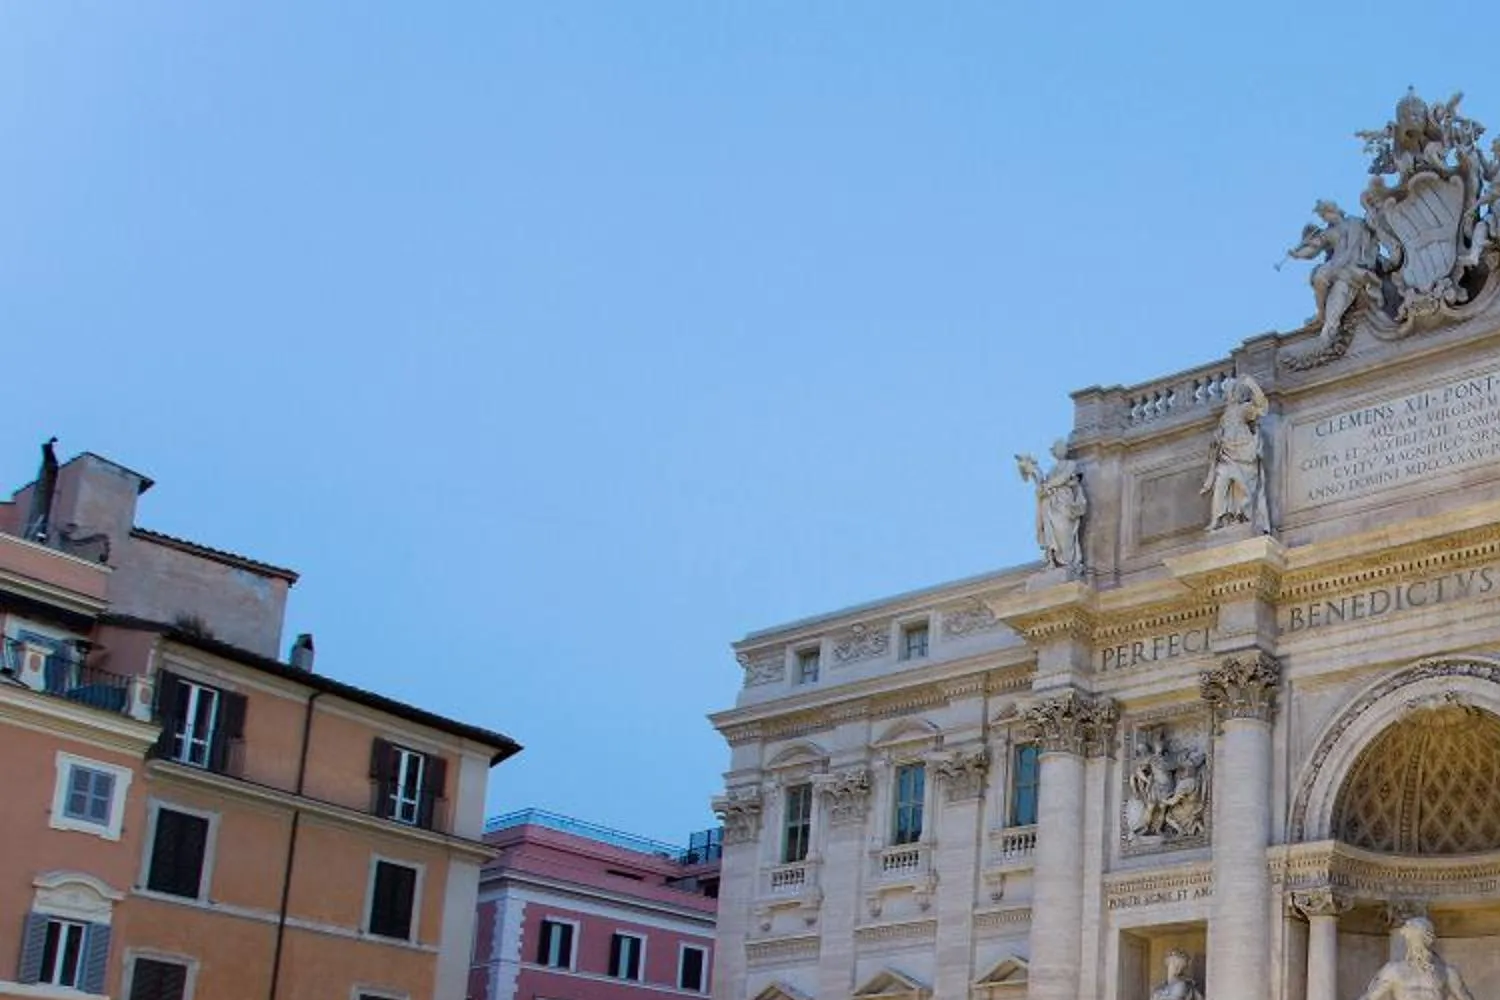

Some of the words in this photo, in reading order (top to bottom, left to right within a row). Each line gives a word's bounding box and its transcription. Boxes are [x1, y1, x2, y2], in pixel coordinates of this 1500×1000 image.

[1315, 406, 1394, 437] CLEMENS
[1289, 567, 1494, 632] BENEDICTVS
[1177, 887, 1188, 901] ET
